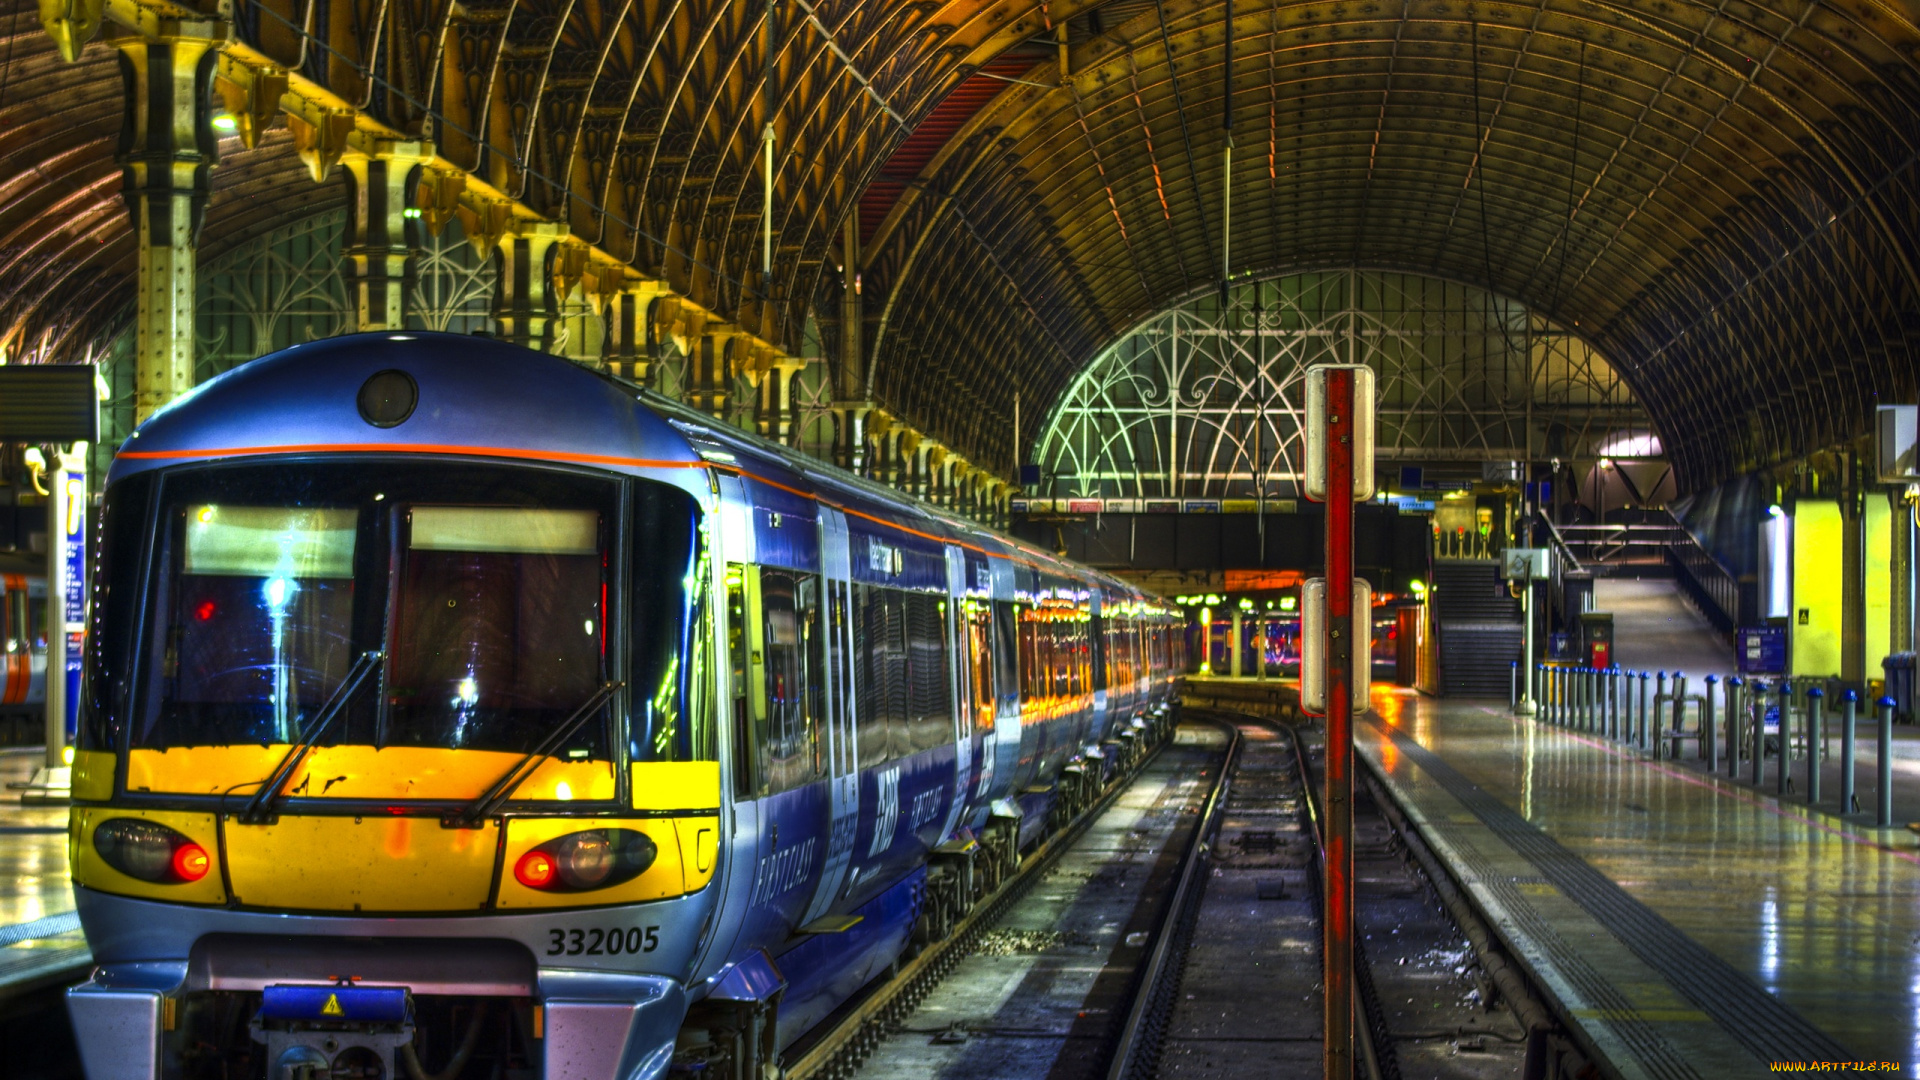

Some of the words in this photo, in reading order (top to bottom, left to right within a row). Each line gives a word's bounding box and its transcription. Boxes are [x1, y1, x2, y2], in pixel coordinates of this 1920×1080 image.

[66, 479, 83, 535] 1
[752, 848, 790, 910] FIRST
[783, 836, 816, 893] CLASS
[547, 925, 660, 956] 332005
